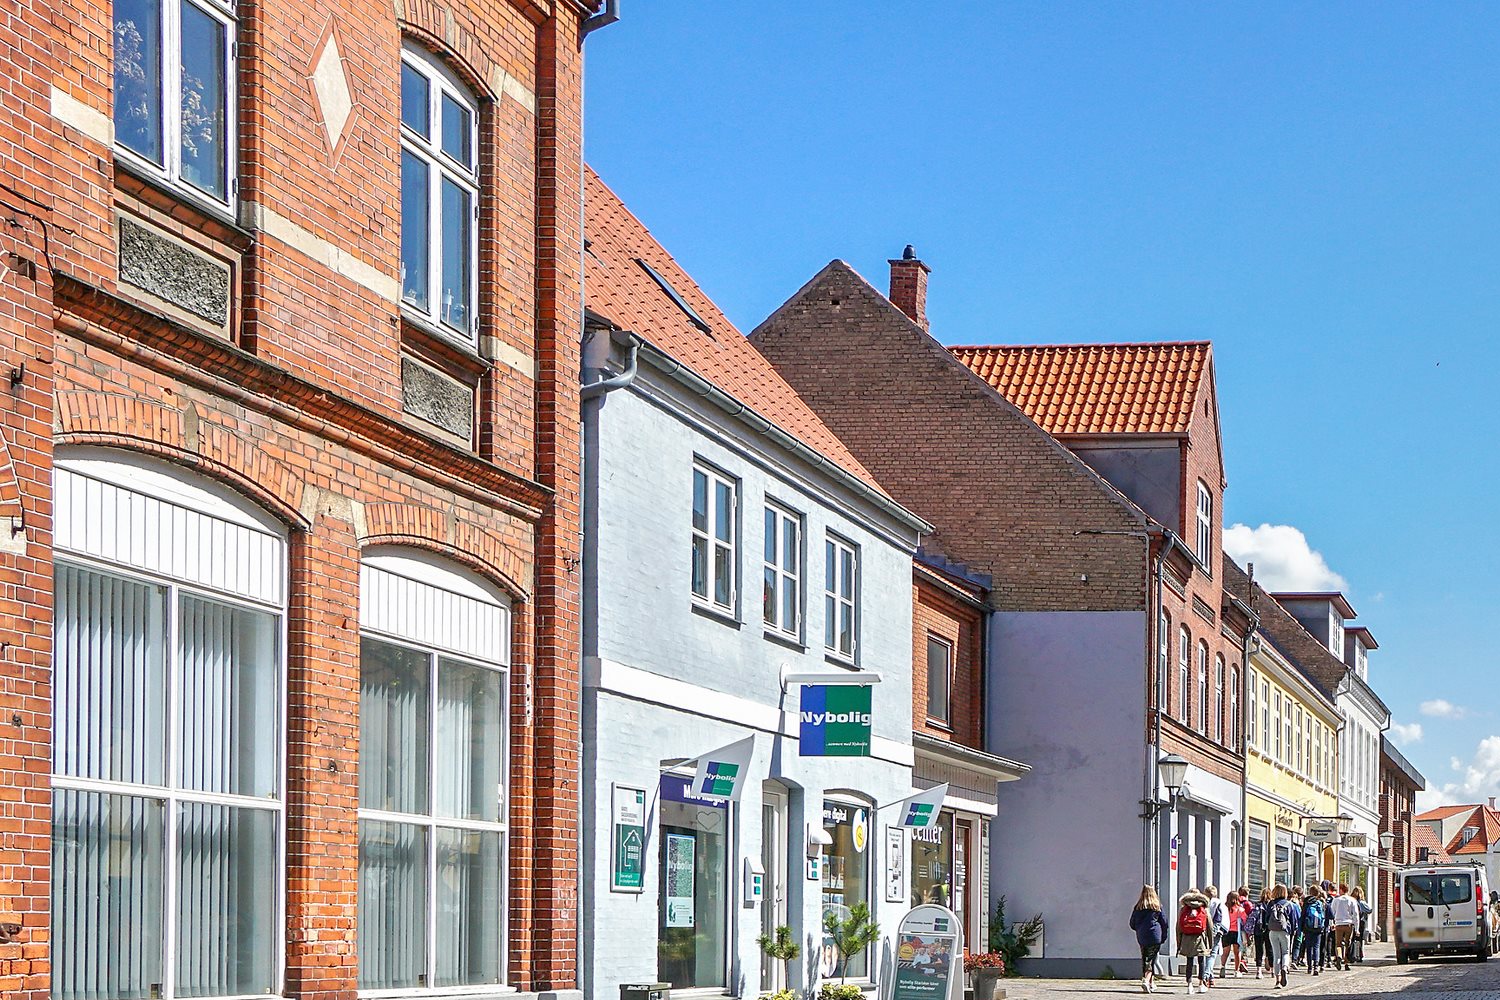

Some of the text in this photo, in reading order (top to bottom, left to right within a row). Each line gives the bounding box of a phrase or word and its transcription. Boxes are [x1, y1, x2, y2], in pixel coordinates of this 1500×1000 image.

[800, 711, 871, 727] Nybolig
[705, 773, 736, 783] Nybolig
[1347, 835, 1364, 847] PTIK
